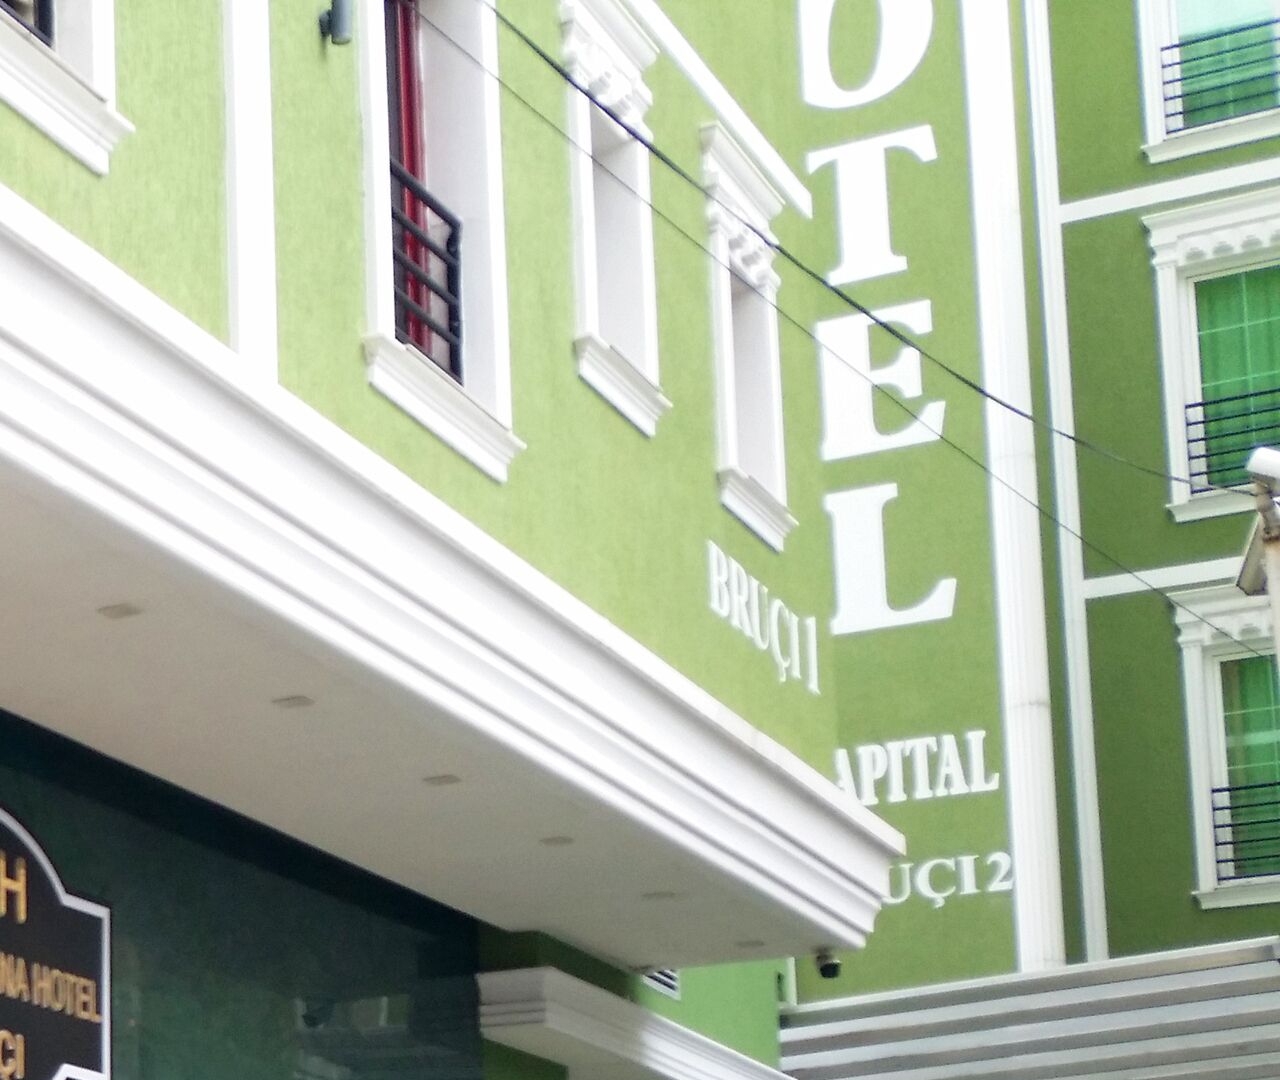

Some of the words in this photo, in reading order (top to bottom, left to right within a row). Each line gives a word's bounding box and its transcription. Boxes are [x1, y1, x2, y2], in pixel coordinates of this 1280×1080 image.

[707, 540, 801, 682] BRUÇI
[987, 852, 1015, 892] 2
[32, 962, 102, 1024] HOTEL
